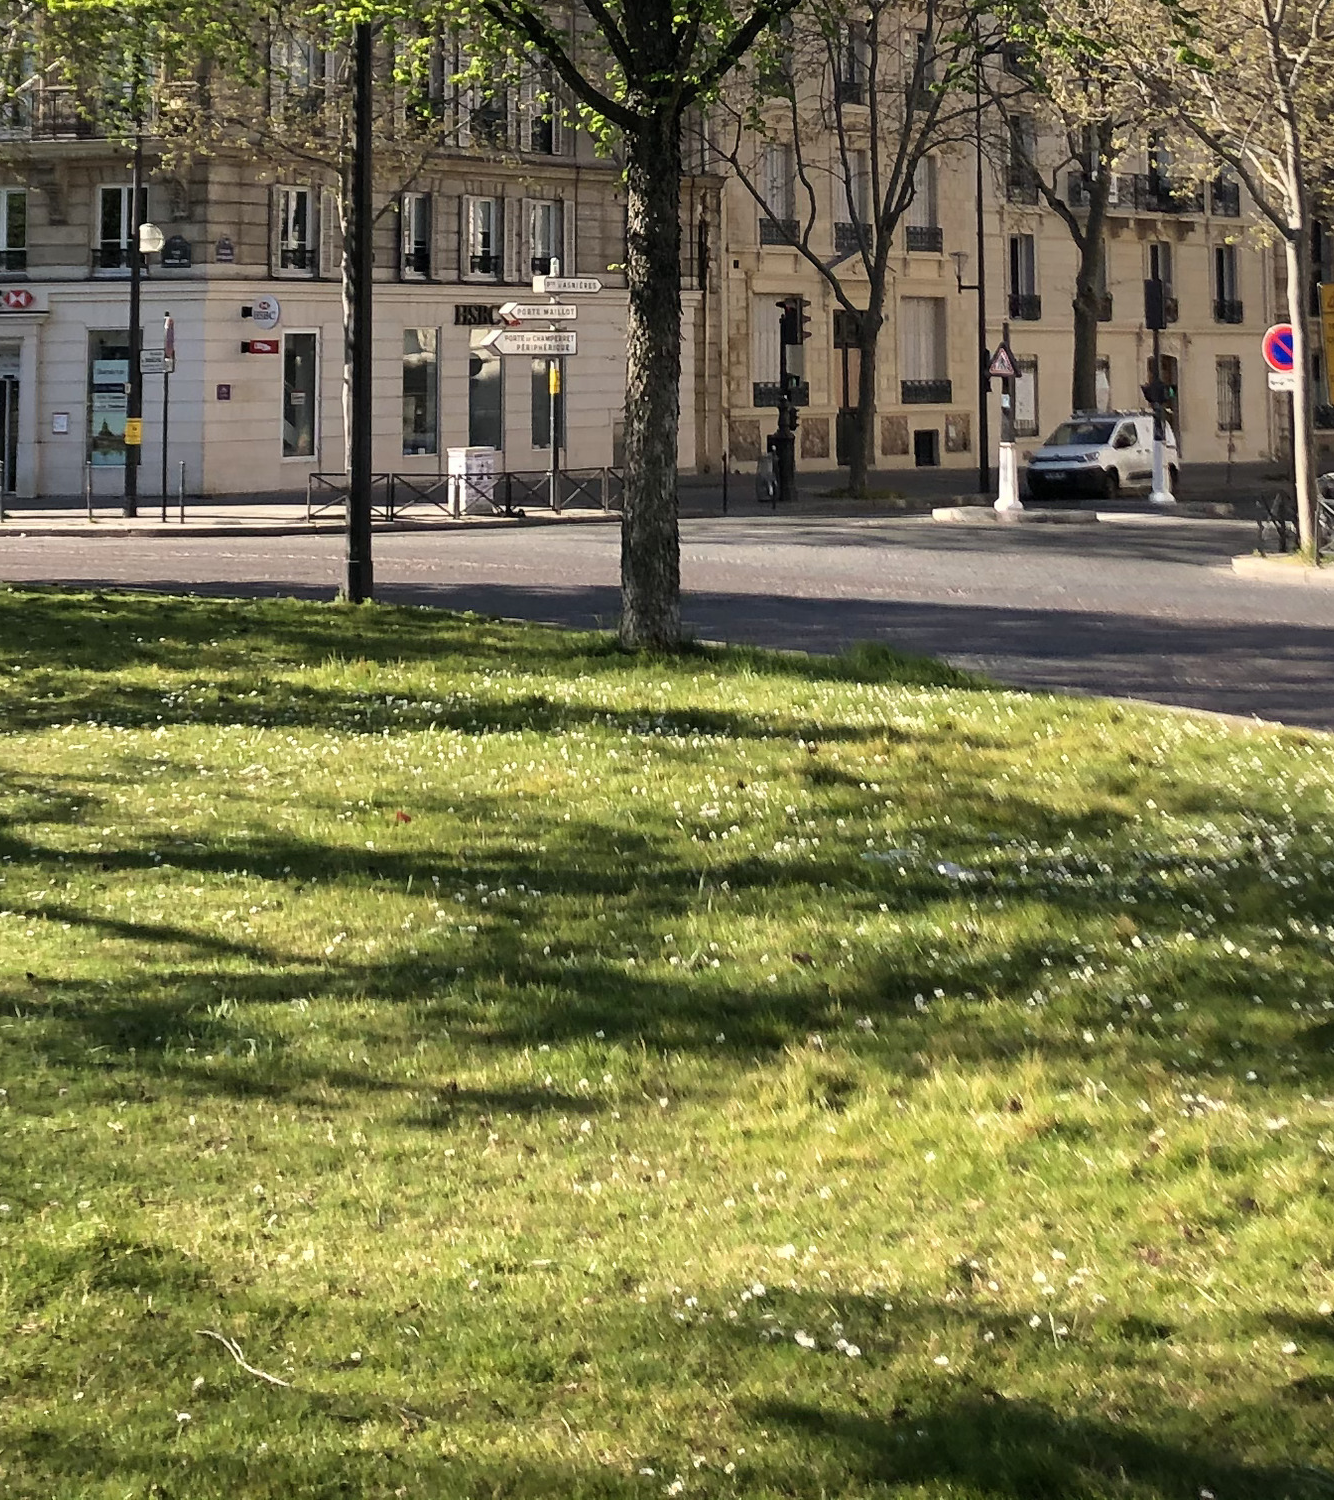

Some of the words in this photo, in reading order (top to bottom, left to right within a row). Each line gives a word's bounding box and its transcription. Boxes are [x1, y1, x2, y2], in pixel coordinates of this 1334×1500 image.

[454, 304, 503, 325] HSBC
[517, 307, 540, 316] PORTE
[543, 307, 575, 316] MAILLOT
[504, 334, 525, 342] PORTE
